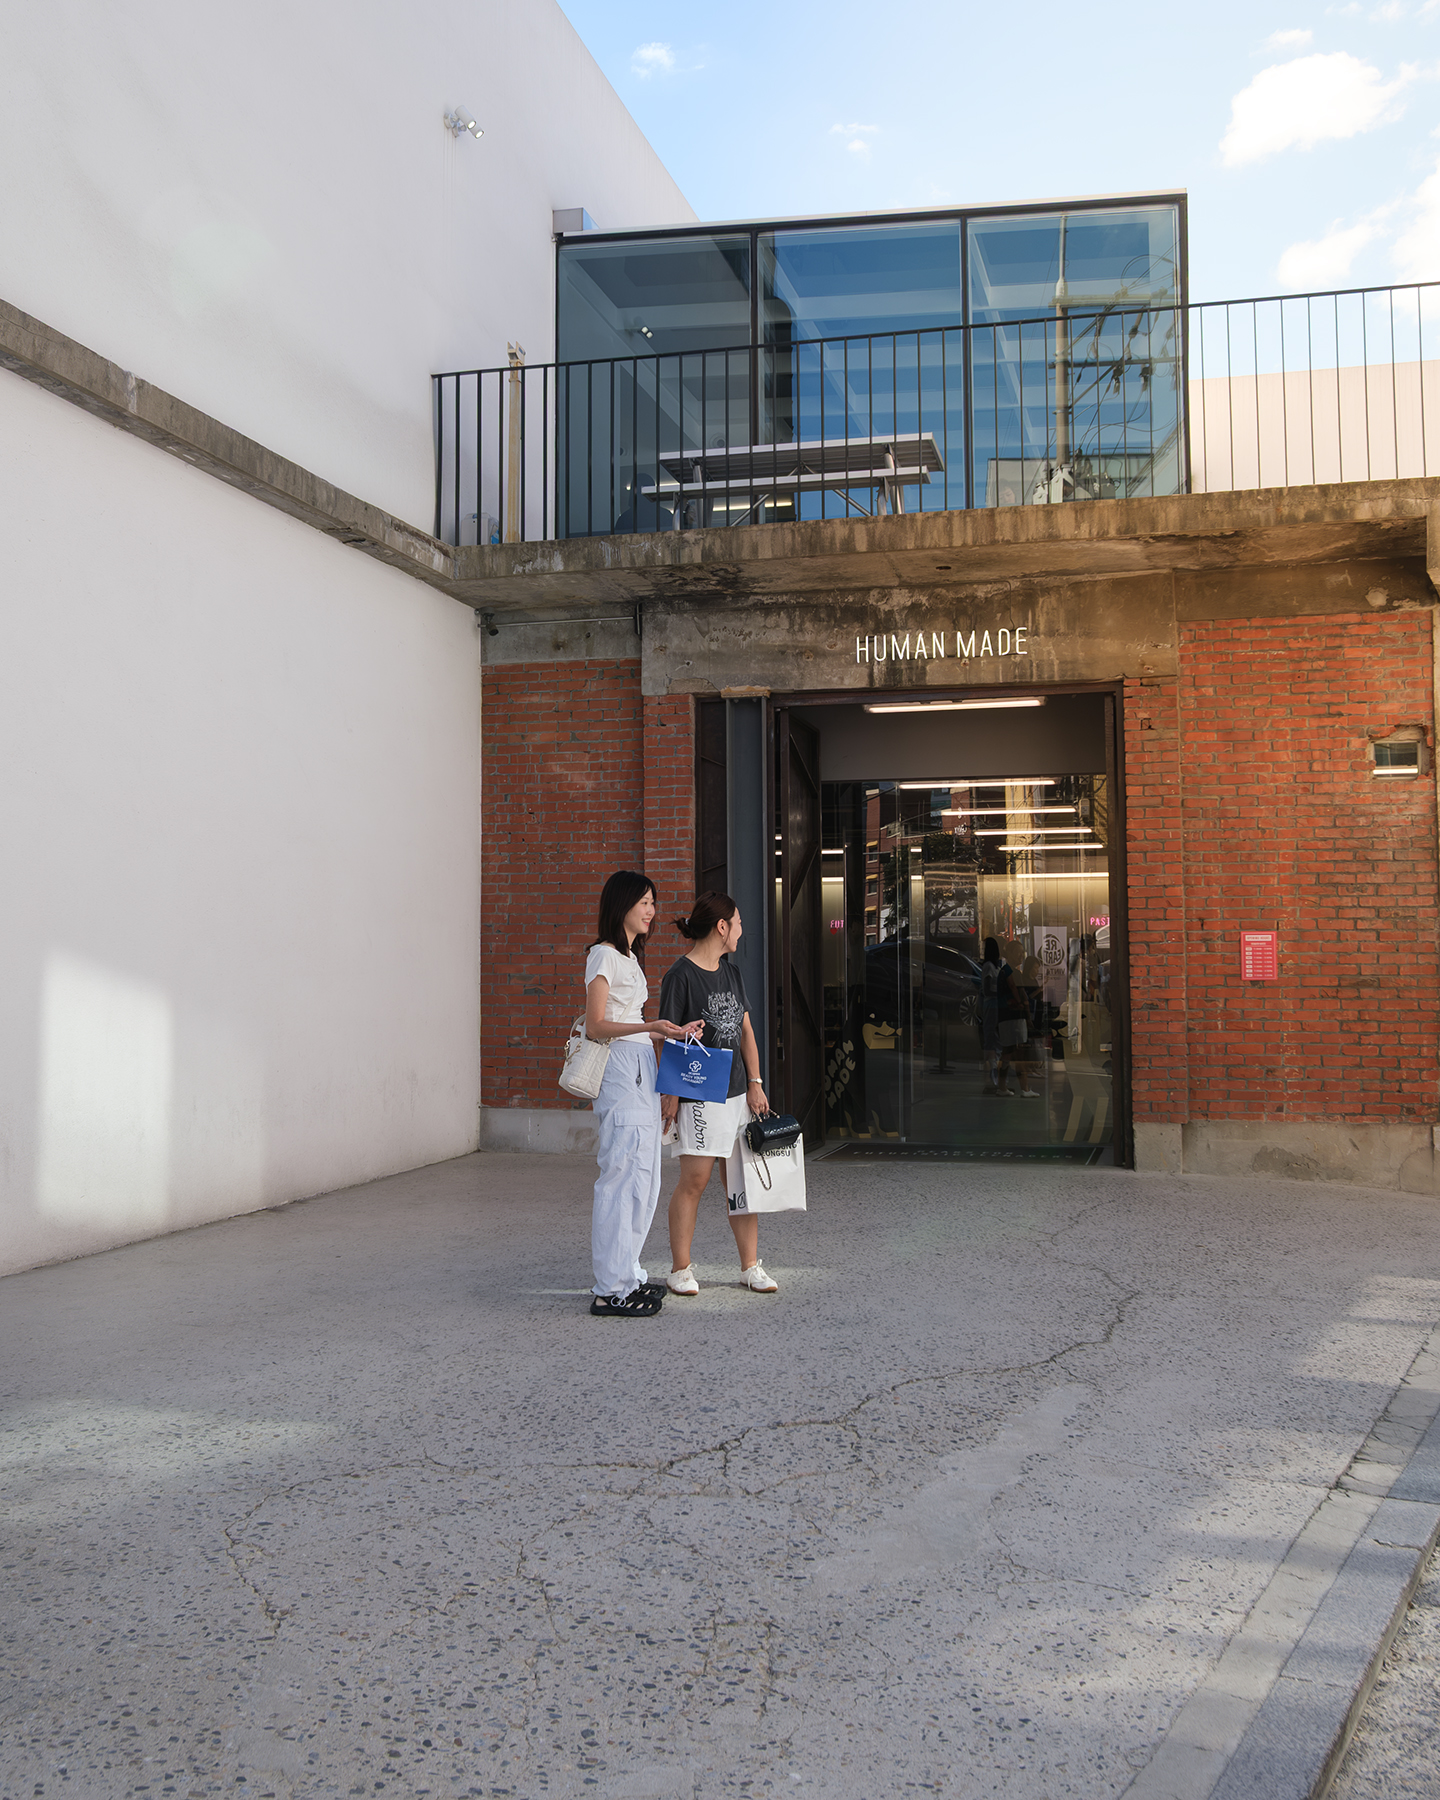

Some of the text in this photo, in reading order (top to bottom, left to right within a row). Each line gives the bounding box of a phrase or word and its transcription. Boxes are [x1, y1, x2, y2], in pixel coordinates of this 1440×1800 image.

[856, 627, 1028, 663] HUMAN MADE
[1090, 916, 1110, 926] PAST
[825, 1040, 854, 1092] UMAN
[828, 1057, 855, 1109] MADE
